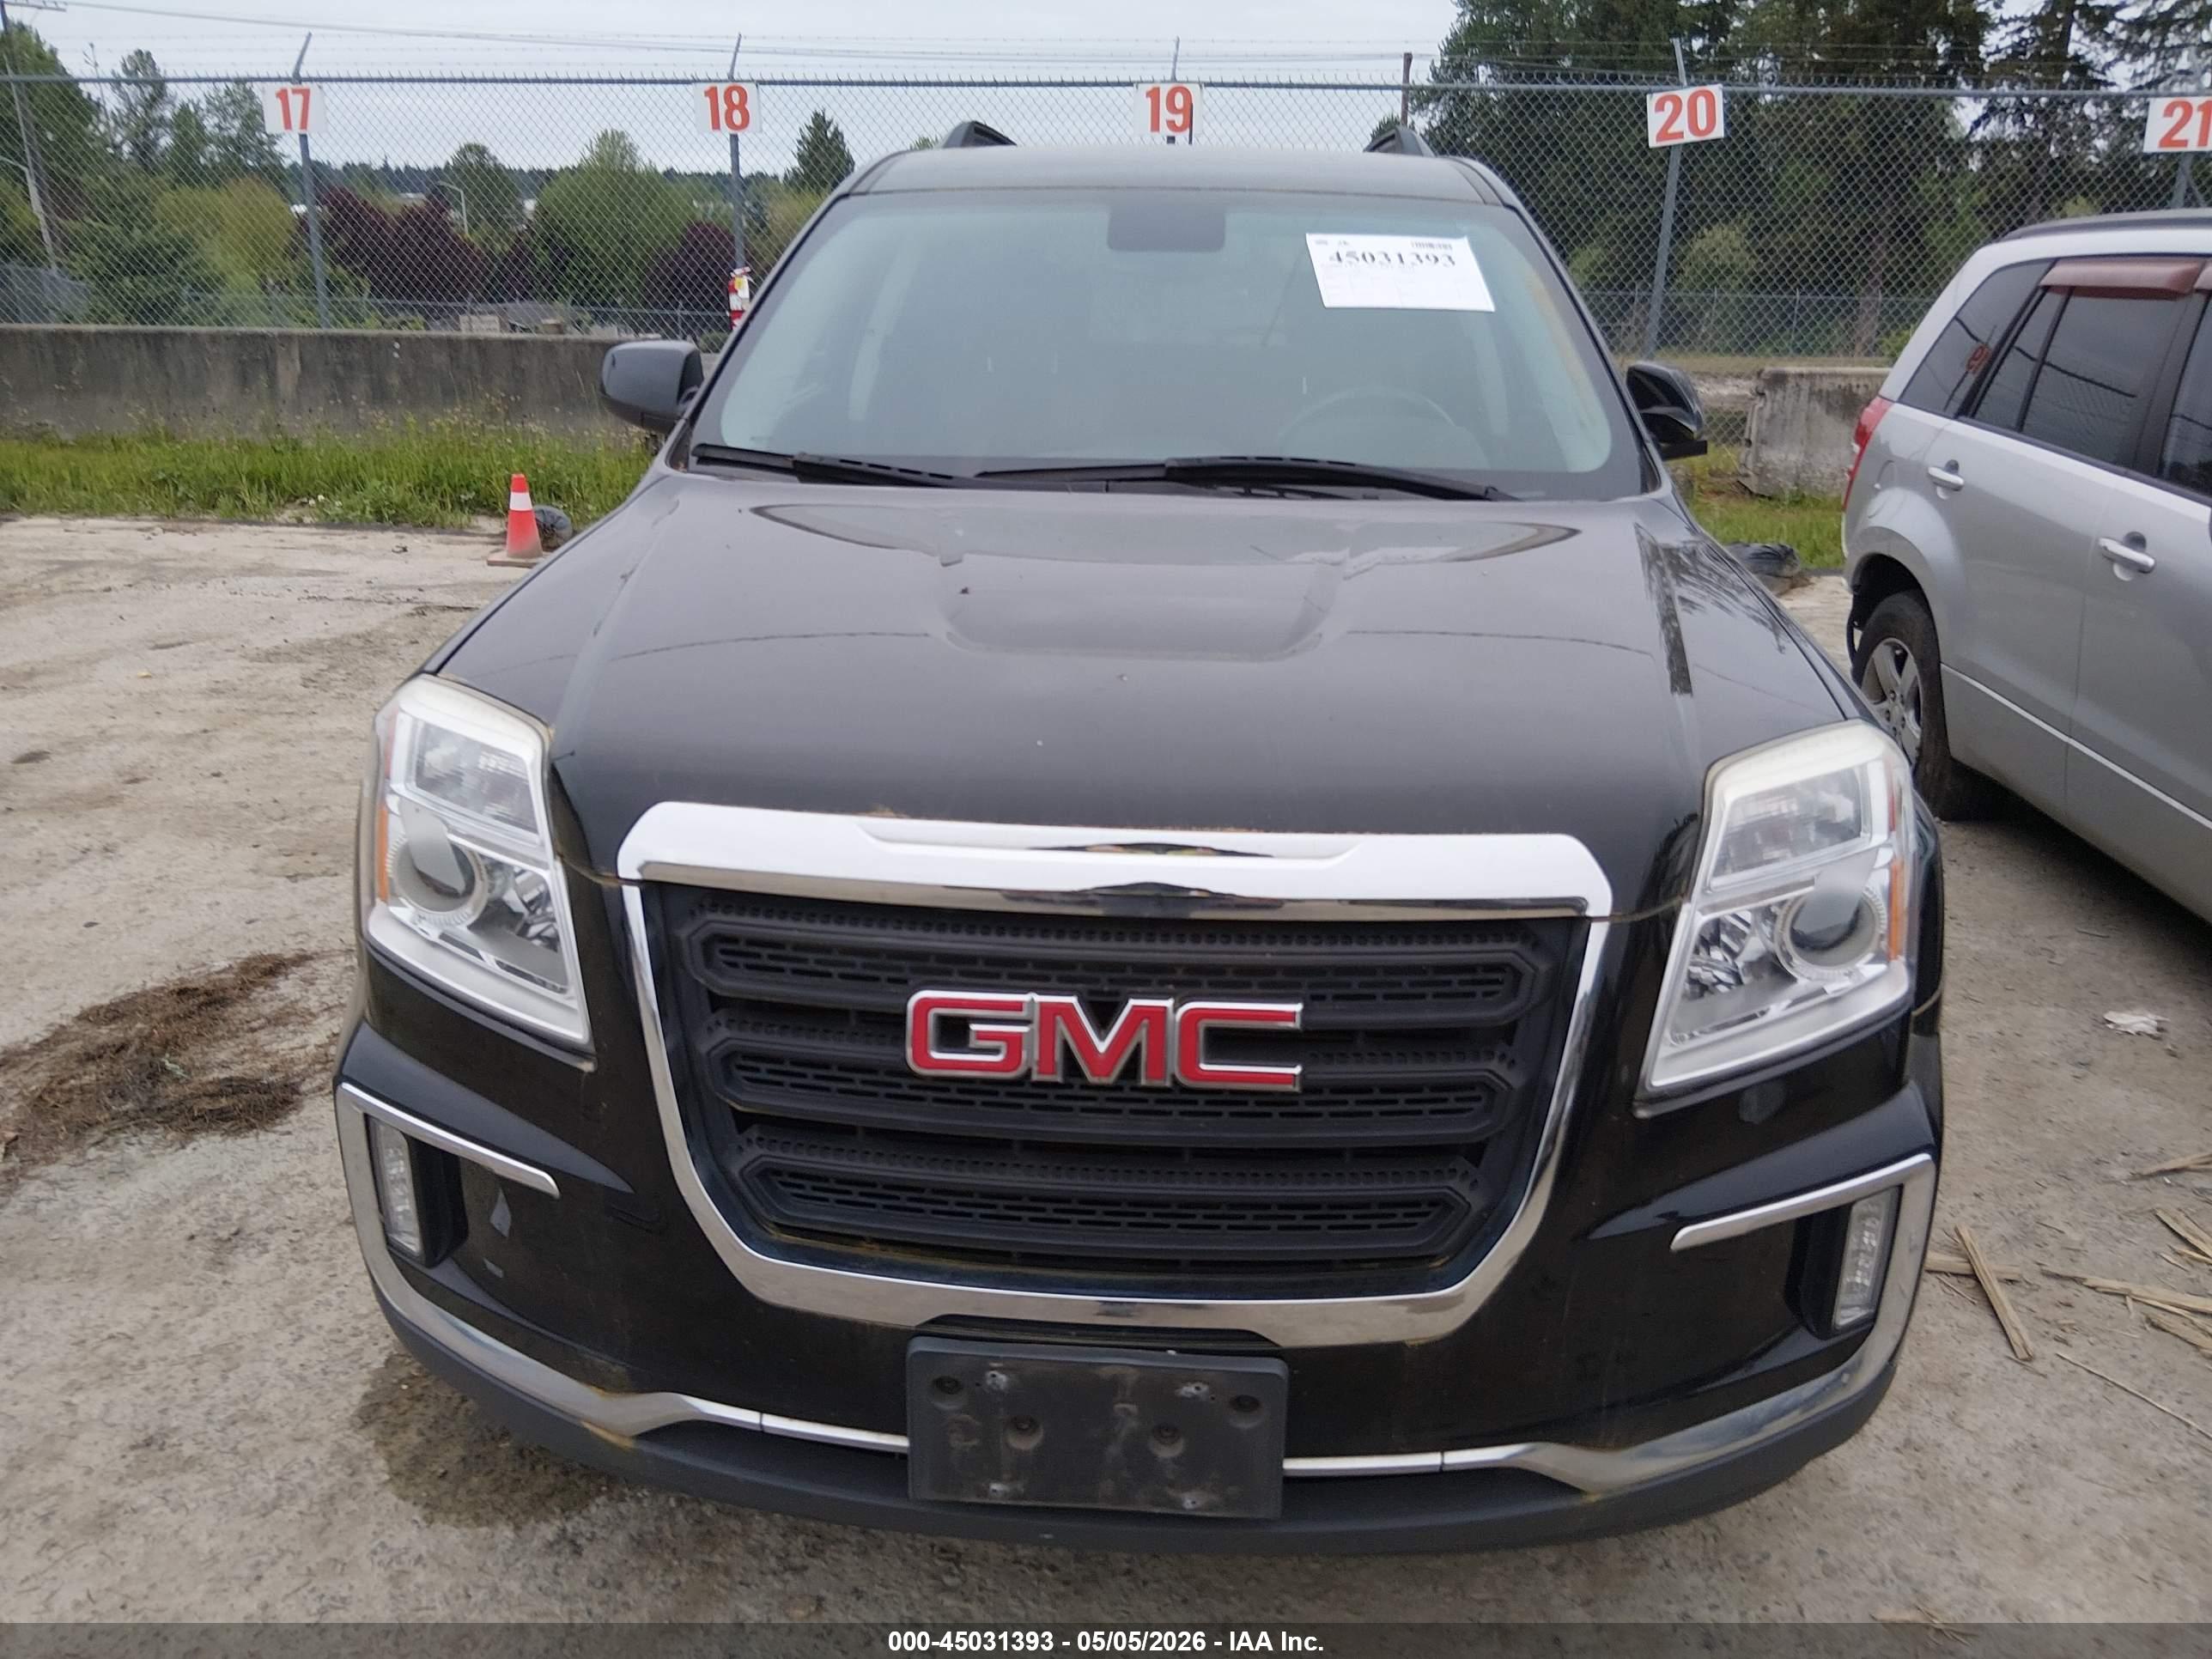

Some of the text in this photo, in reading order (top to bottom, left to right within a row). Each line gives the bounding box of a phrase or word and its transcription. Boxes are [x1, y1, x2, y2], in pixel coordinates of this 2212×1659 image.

[276, 88, 310, 131] 17
[704, 86, 750, 131] 18
[1146, 86, 1193, 132] 19
[1655, 89, 1717, 143] 20
[2158, 100, 2212, 149] 21
[1329, 250, 1456, 268] 45031393
[907, 989, 1303, 1091] GMC
